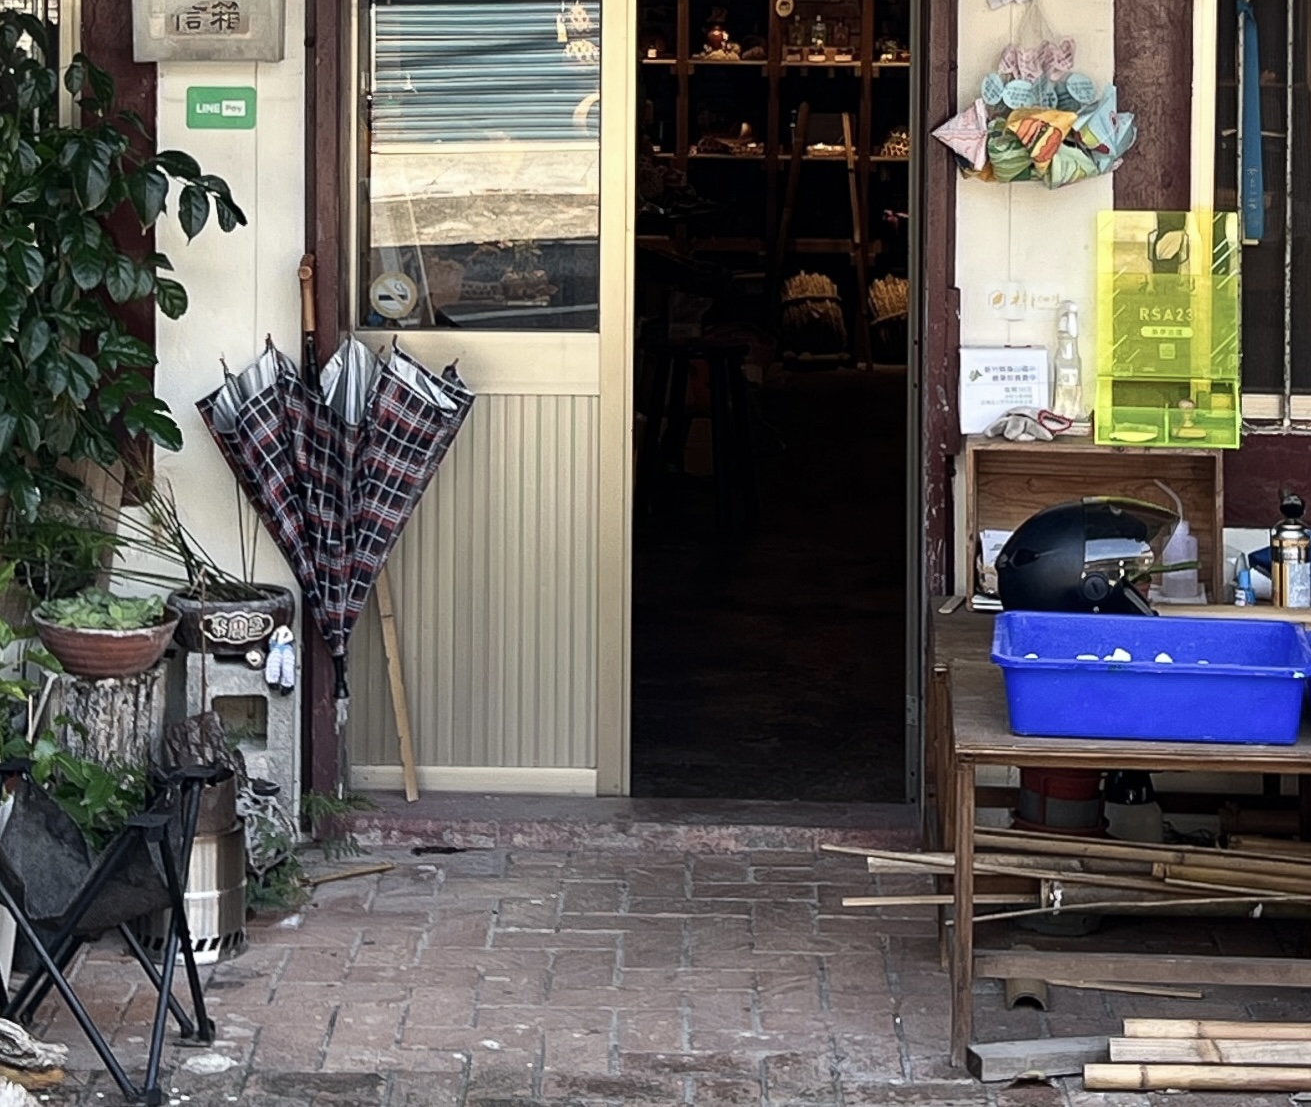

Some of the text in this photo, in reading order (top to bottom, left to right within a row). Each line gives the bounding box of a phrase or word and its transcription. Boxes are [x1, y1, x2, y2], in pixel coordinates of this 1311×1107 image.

[171, 0, 240, 31] 信箱
[196, 102, 243, 114] LINE Pay
[1139, 307, 1193, 321] RSA23
